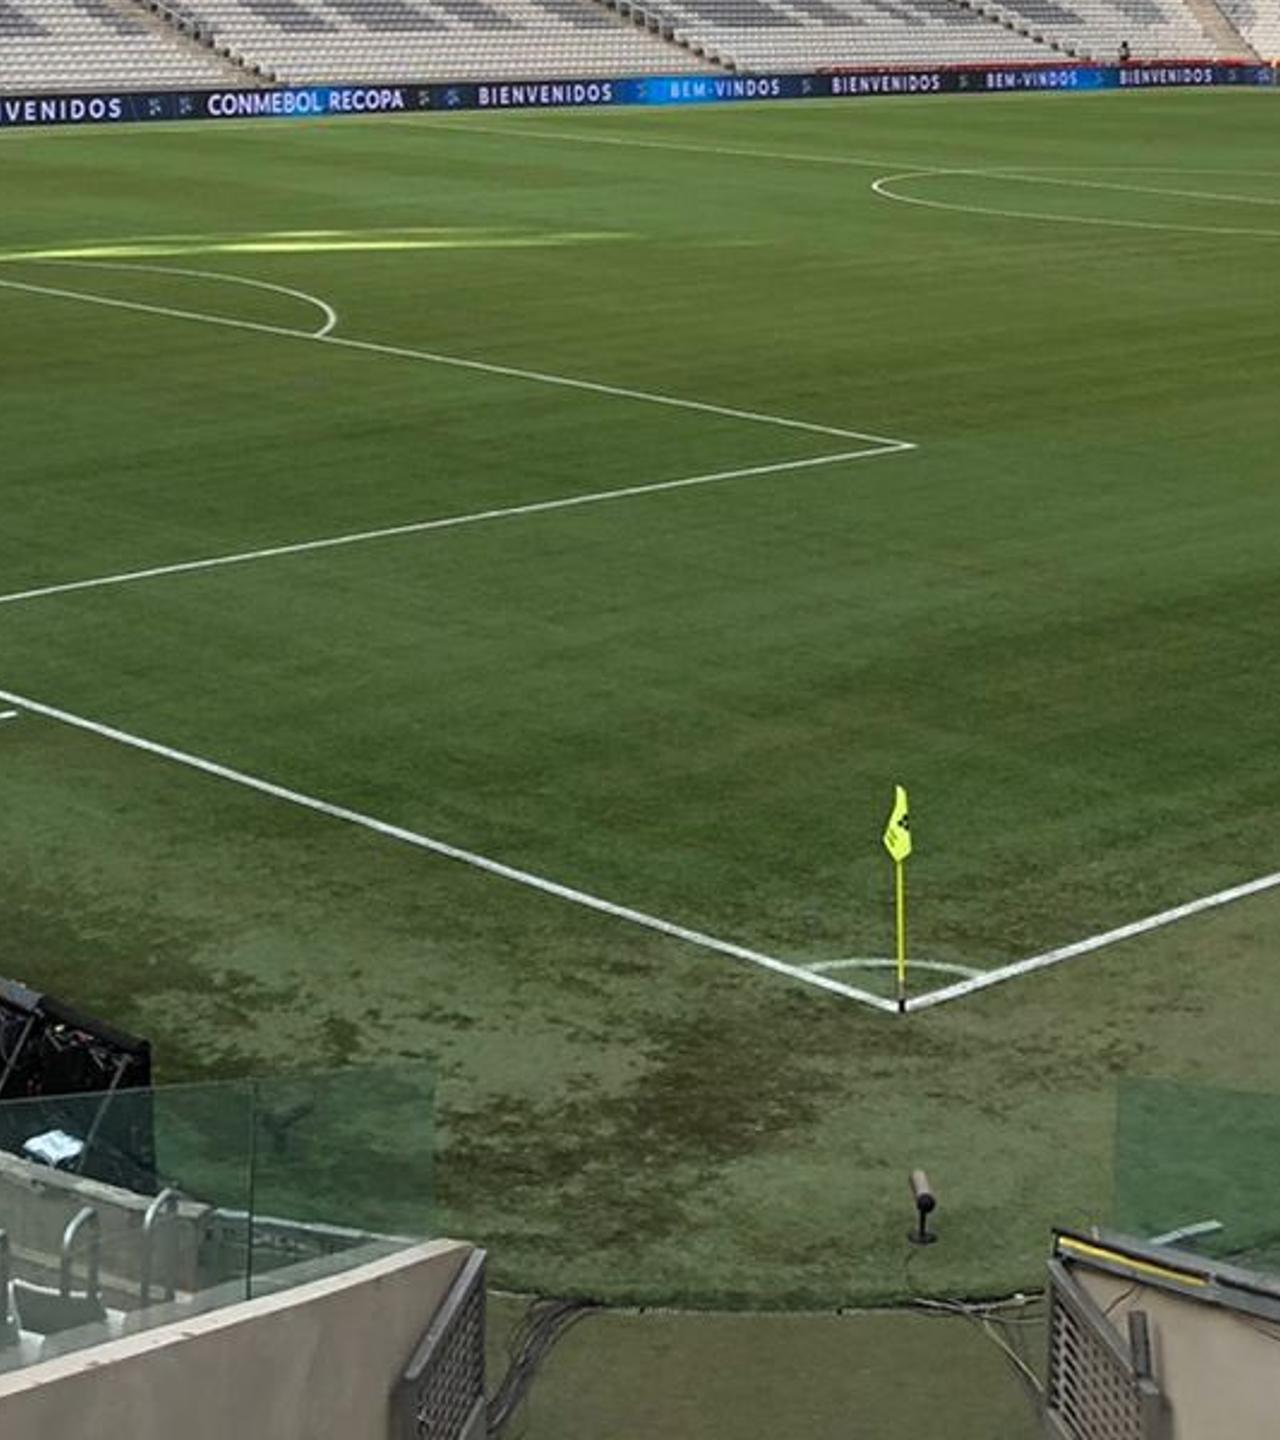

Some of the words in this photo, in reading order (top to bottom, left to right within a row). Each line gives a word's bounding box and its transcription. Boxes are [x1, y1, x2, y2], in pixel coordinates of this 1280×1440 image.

[832, 74, 940, 93] BIENVENIDOS
[986, 70, 1078, 90] BEM-VINDOS
[1120, 67, 1213, 86] BIENVENIDOS
[478, 83, 613, 106] BIENVENIDOS
[670, 78, 780, 99] BEM-VINDOS
[208, 91, 321, 116] CONMEBOL
[329, 87, 404, 111] RECOPA
